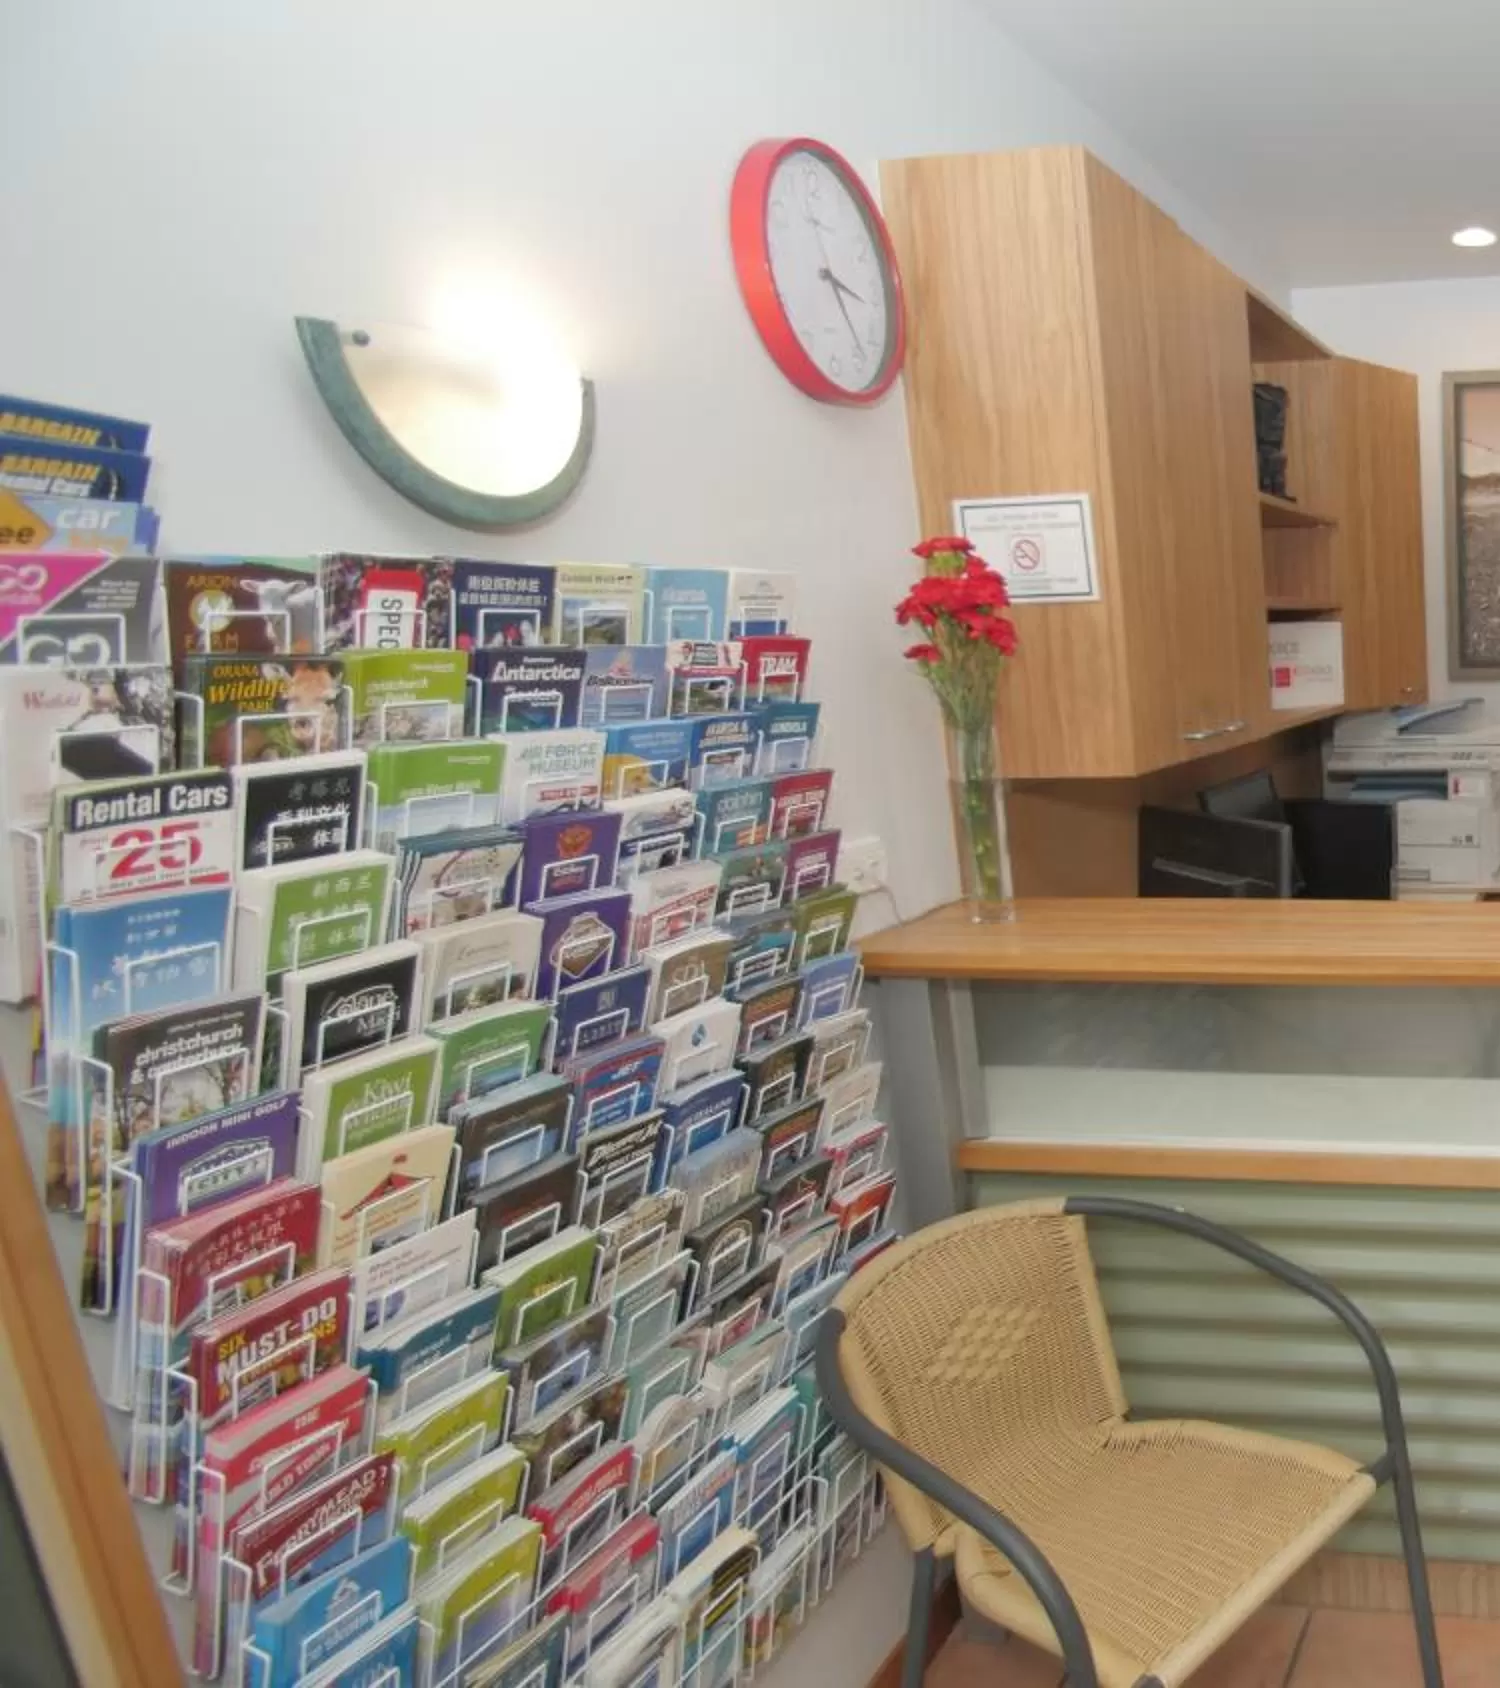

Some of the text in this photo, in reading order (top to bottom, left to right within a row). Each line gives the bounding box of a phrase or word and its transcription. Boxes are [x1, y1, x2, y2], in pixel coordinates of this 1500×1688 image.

[0, 411, 101, 446] BARGAIN
[0, 454, 101, 482] BARGAIN
[56, 507, 121, 530] car
[491, 660, 582, 683] Antarctica
[207, 679, 292, 704] Wildlife
[75, 785, 228, 828] Rental Cars
[110, 821, 204, 880] 25
[135, 1024, 243, 1067] christchurch
[166, 1097, 289, 1150] INDOOR MINI GOLF
[216, 1296, 338, 1384] MUST-DO
[218, 1330, 247, 1361] SIX
